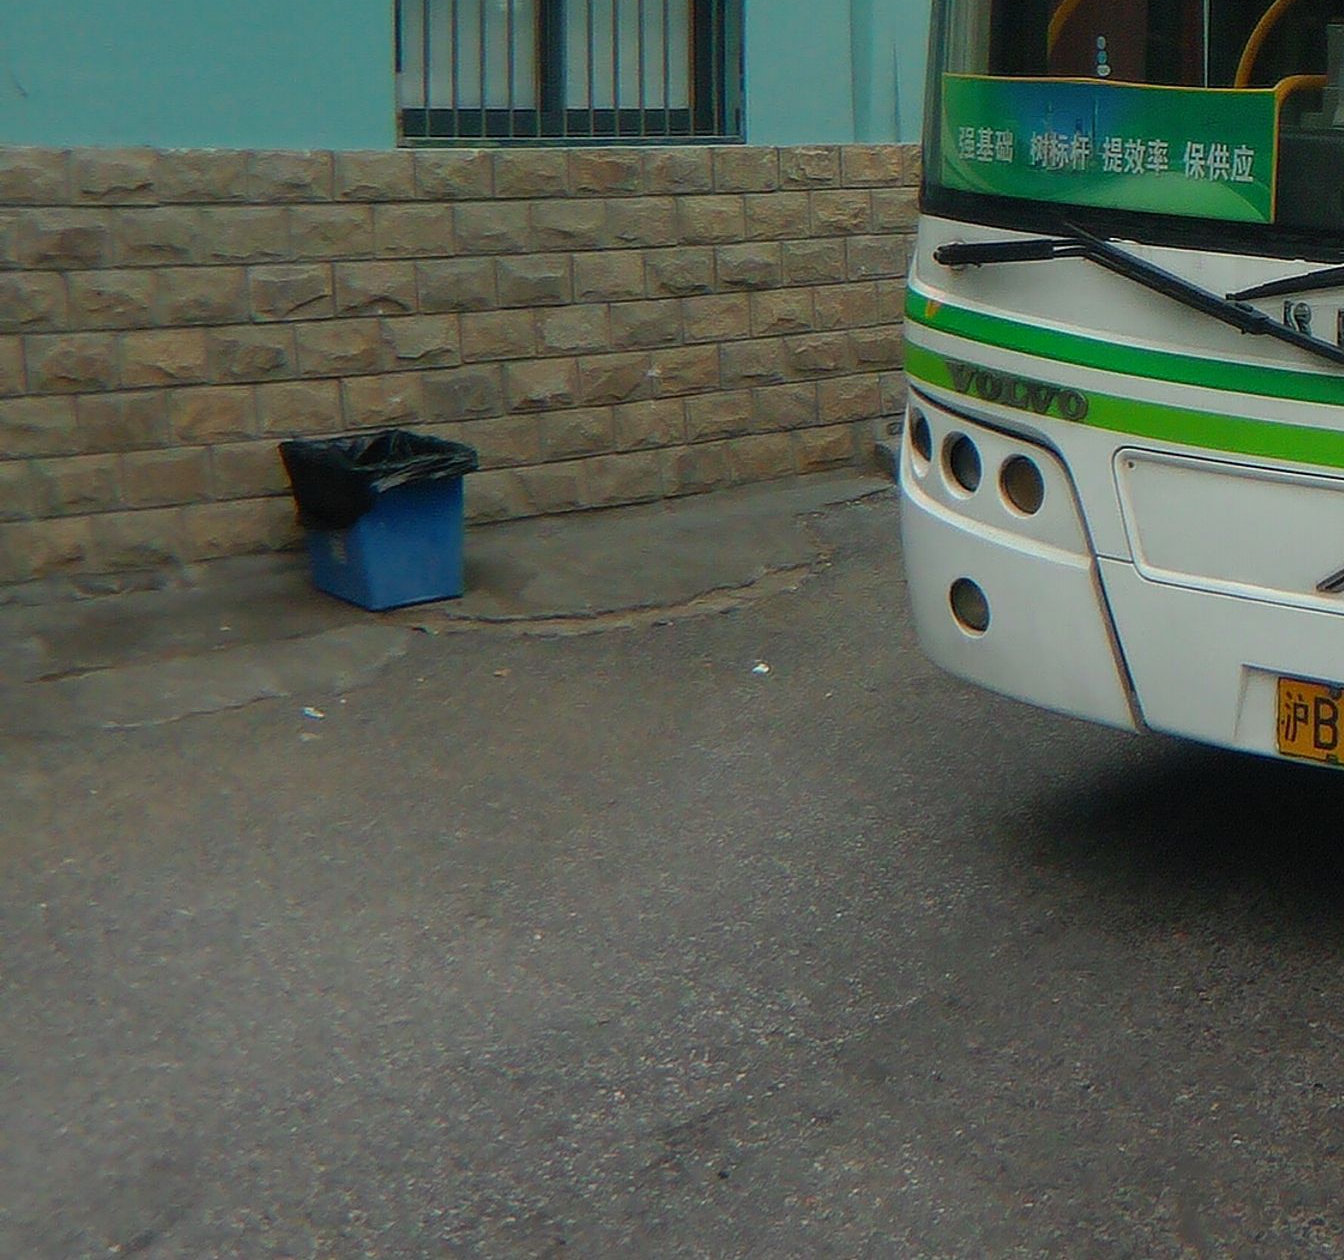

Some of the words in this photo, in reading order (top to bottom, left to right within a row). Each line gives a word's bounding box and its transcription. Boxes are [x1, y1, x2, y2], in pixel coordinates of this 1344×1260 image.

[958, 126, 1014, 164] 强基础
[1102, 136, 1169, 176] 提效率
[1184, 141, 1255, 183] 保供应
[945, 358, 1088, 422] VOLVO
